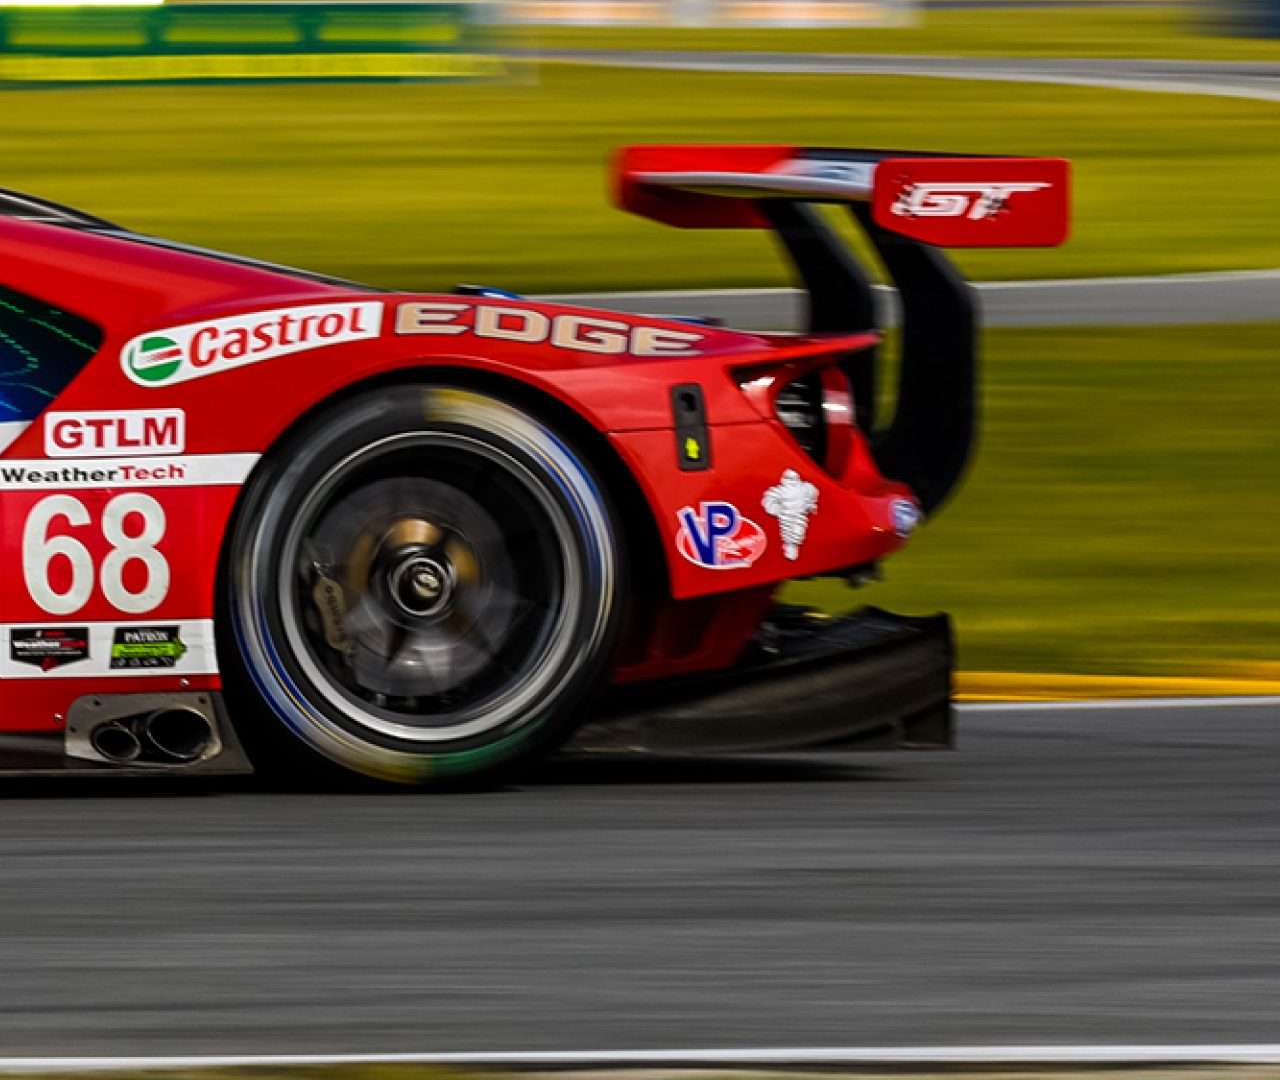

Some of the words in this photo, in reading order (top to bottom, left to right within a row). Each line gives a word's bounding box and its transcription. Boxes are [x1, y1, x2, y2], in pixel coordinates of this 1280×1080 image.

[891, 182, 1053, 220] GT
[188, 307, 366, 367] Castrol
[395, 302, 705, 357] EDGE
[52, 417, 178, 449] GTLM
[1, 464, 185, 483] WeatherTech
[22, 492, 171, 615] 68
[683, 503, 737, 565] VP
